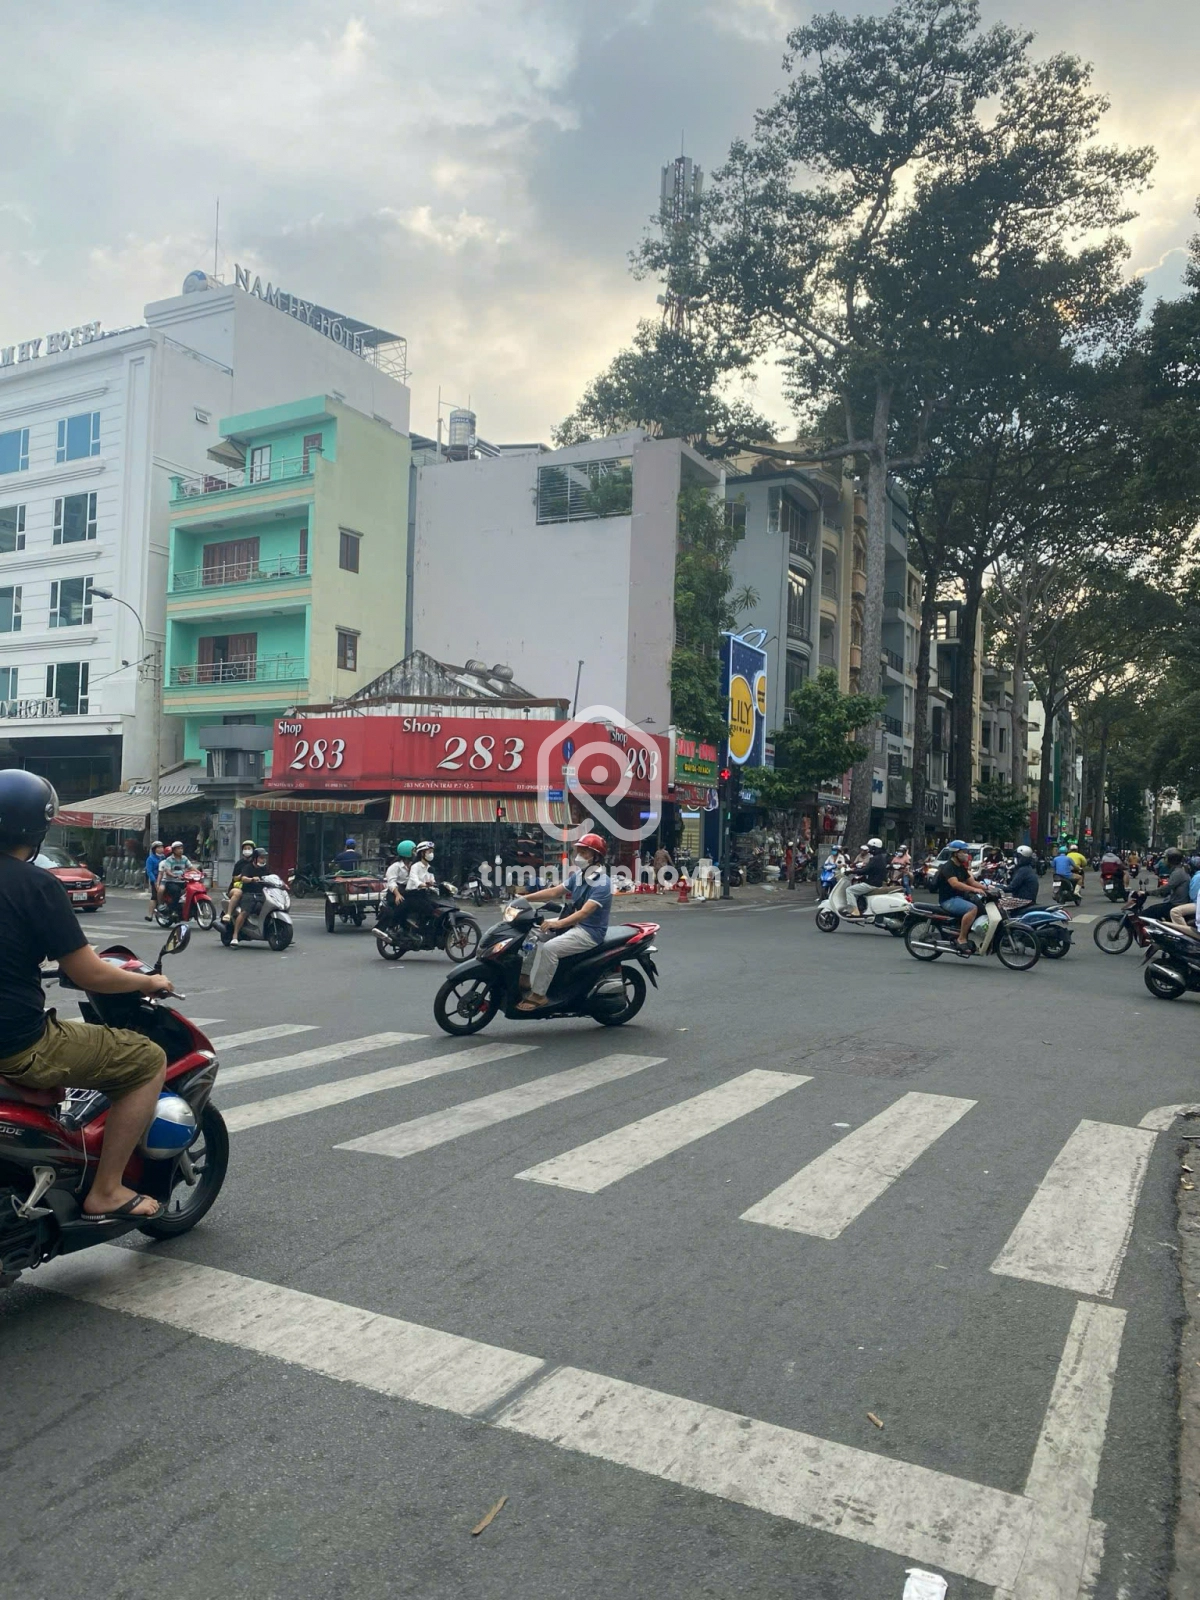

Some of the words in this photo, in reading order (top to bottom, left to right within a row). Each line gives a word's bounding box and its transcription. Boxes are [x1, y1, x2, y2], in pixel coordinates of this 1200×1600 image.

[234, 263, 282, 310] NAM
[288, 293, 314, 327] HY
[319, 312, 367, 360] HOTEL
[17, 338, 42, 362] HY
[46, 321, 104, 354] HOTEL
[16, 698, 62, 718] HOTEL
[731, 697, 752, 726] LILY
[278, 721, 302, 736] Shop
[402, 718, 441, 737] Shop
[290, 738, 346, 770] 283
[437, 735, 525, 772] 283
[625, 747, 659, 781] 283
